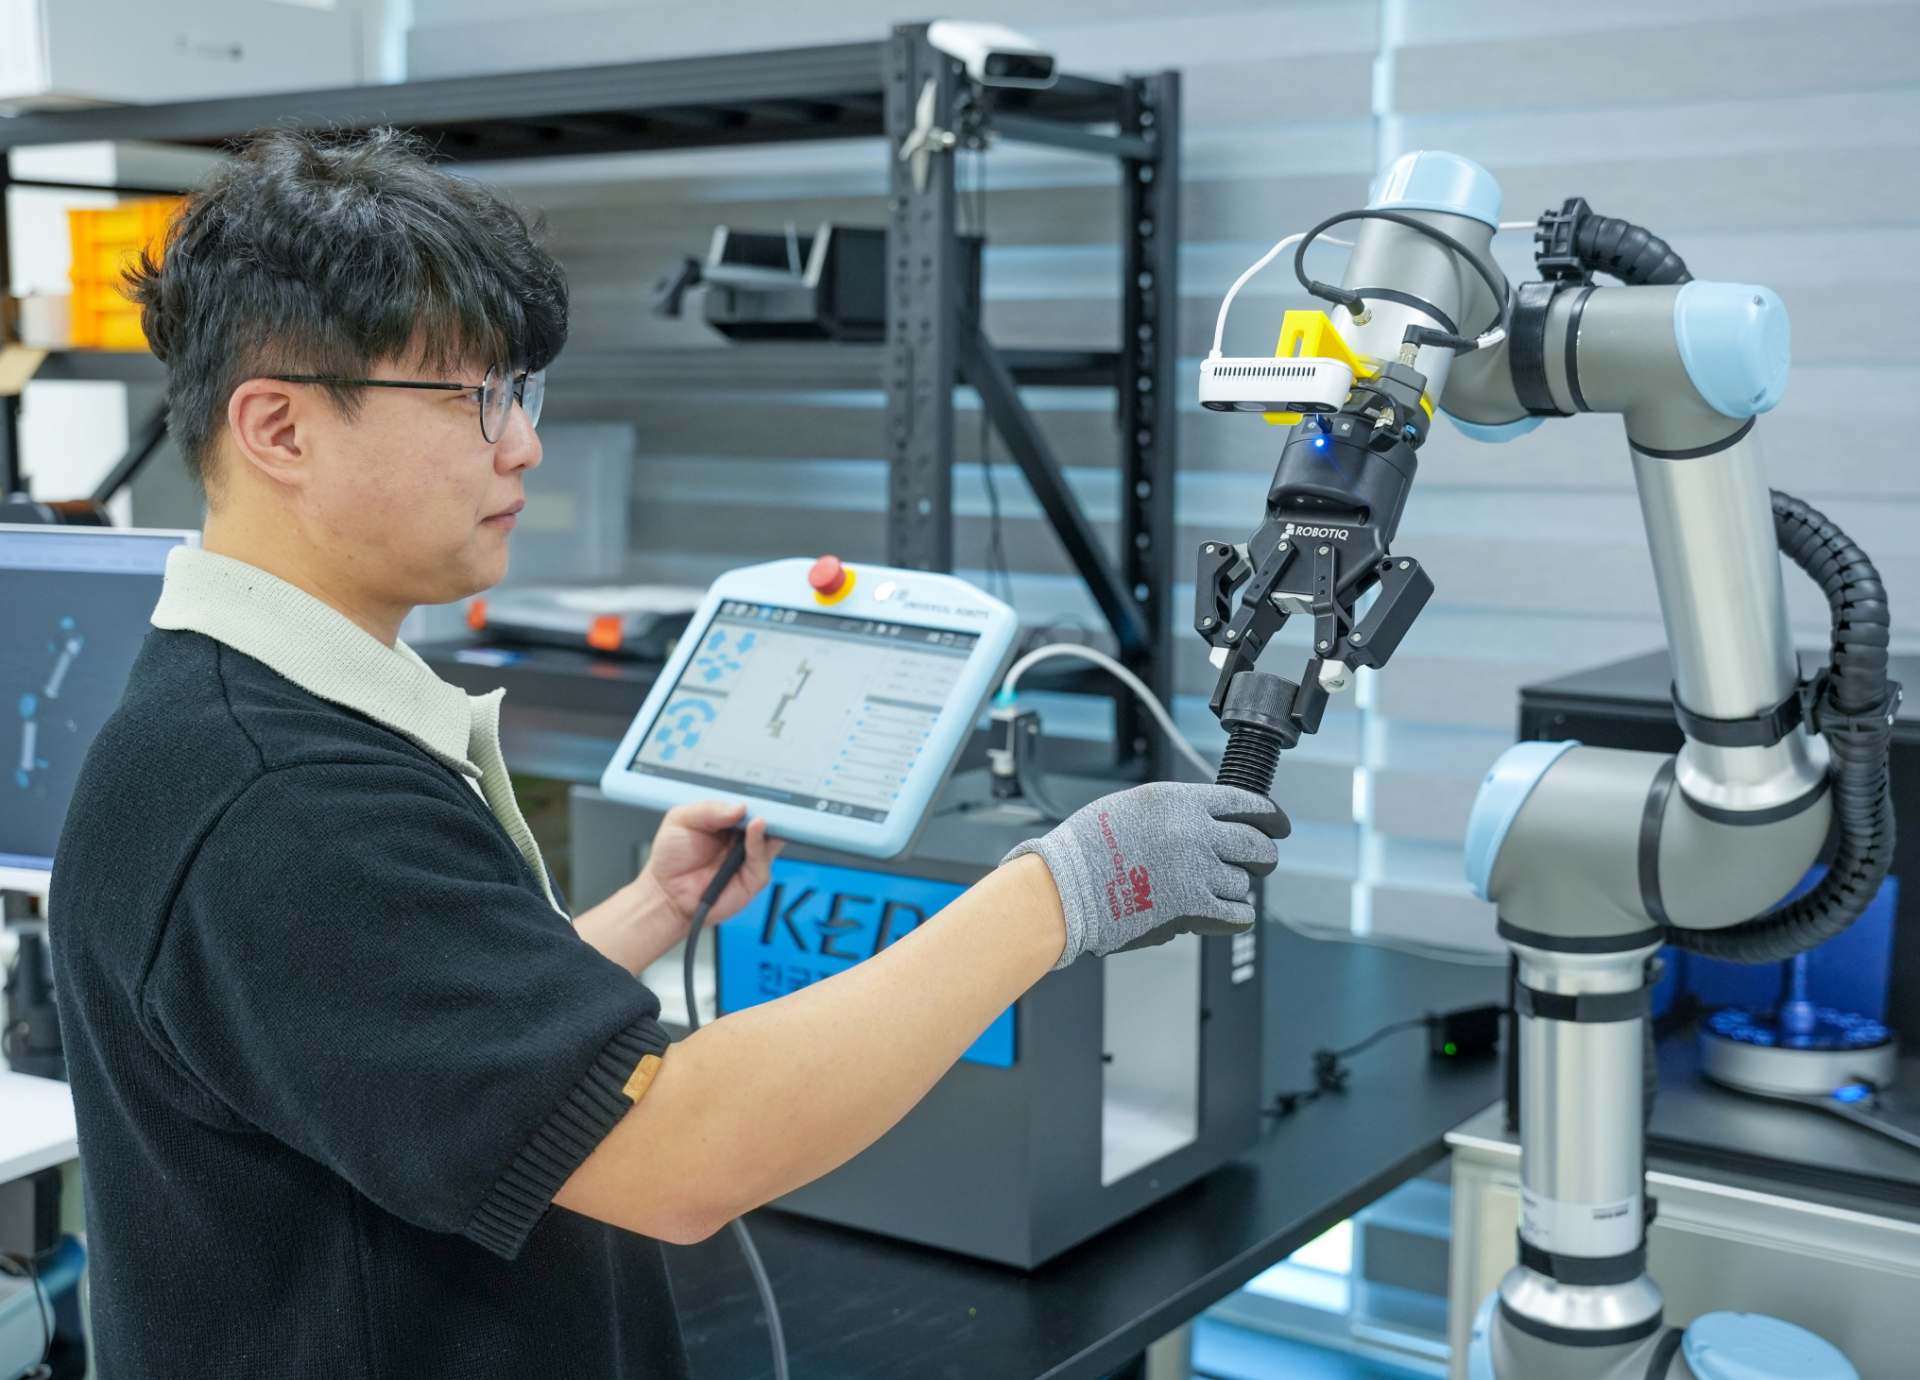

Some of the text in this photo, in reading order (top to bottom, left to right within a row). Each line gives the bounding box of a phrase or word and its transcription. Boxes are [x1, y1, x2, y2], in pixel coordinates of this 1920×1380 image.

[1295, 525, 1349, 541] ROBOTIQ
[1098, 812, 1135, 916] Super Grip 200
[1106, 880, 1121, 921] Touch
[1129, 866, 1154, 912] 3M
